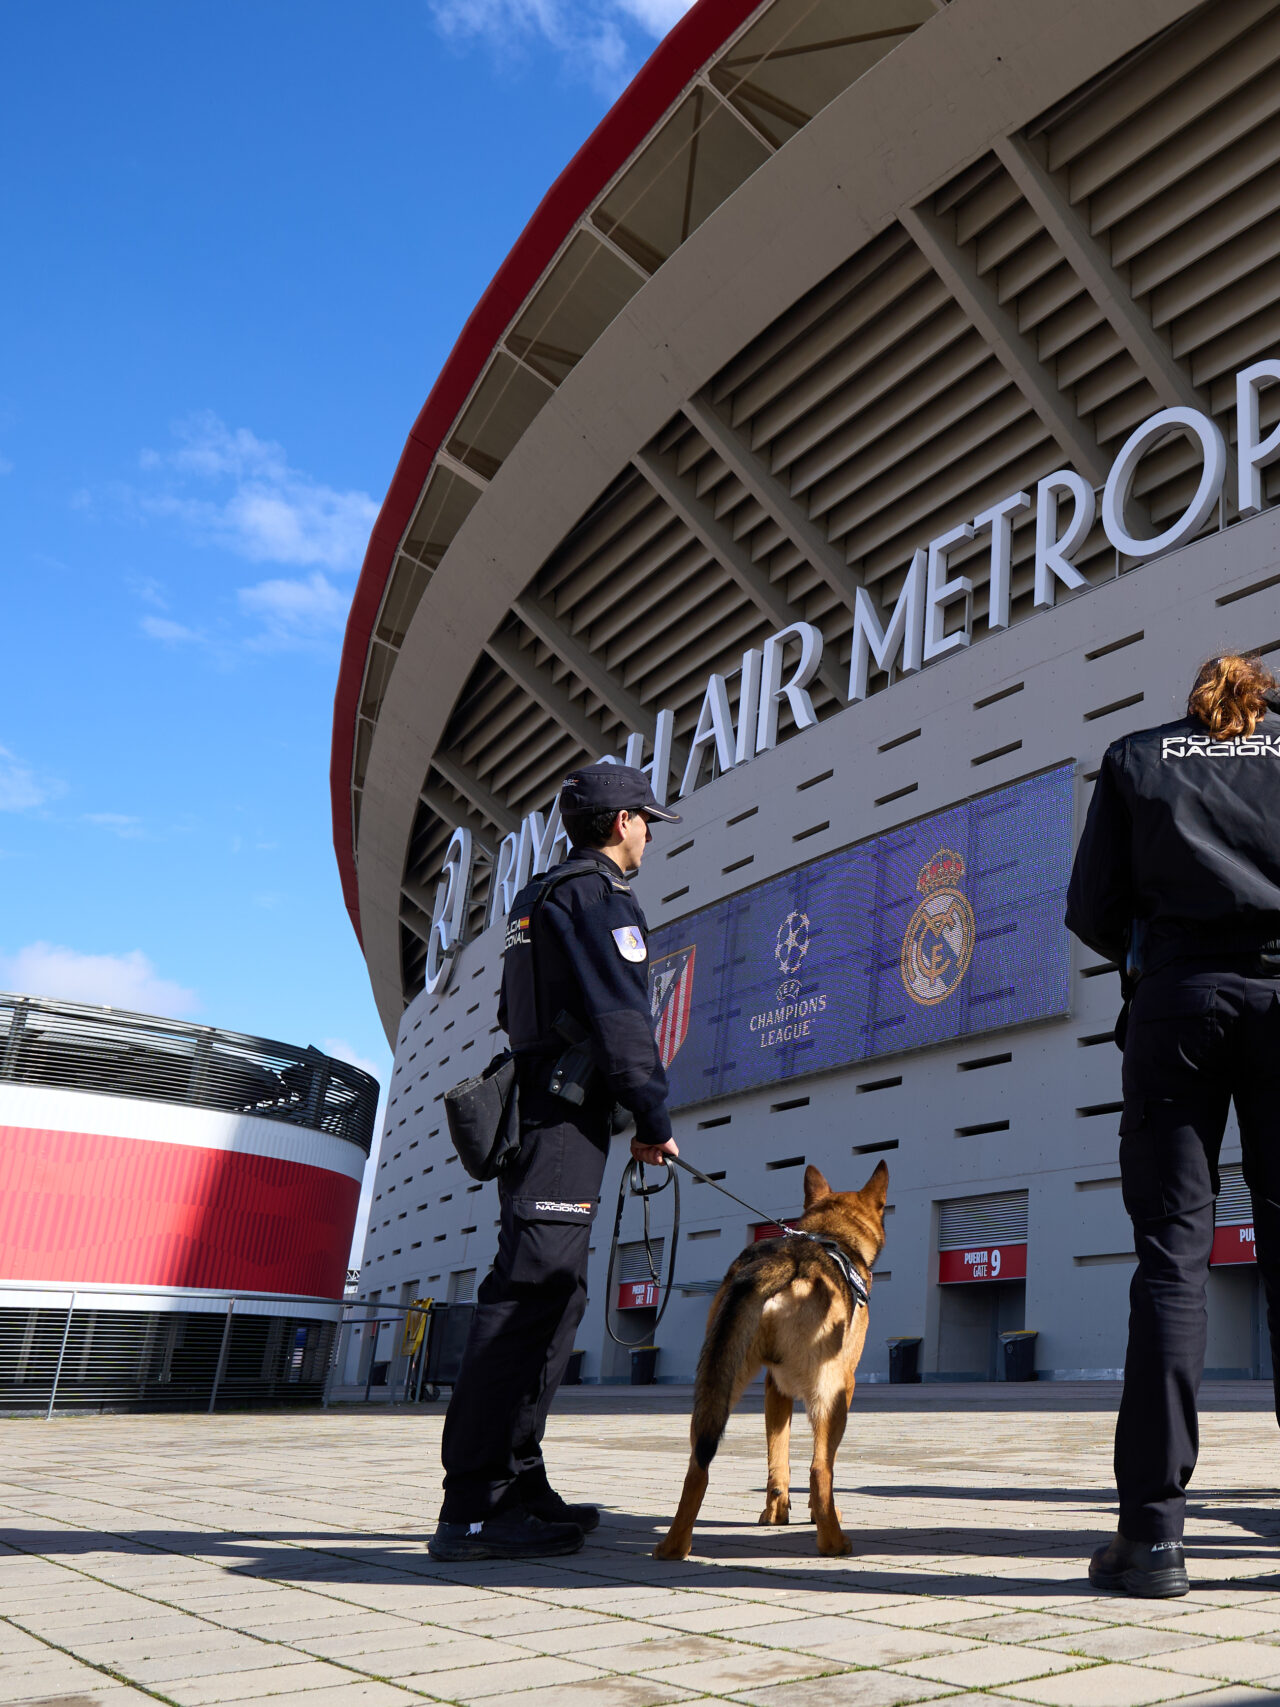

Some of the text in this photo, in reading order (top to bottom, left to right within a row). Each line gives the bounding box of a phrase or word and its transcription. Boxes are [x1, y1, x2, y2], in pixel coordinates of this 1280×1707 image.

[490, 708, 675, 928] RIYAH
[679, 622, 825, 797] AIR
[750, 994, 827, 1032] CHAMPIONS
[761, 1020, 811, 1048] LEAGUE
[535, 1204, 591, 1214] NACIONAL
[964, 1251, 988, 1265] PUERTA
[973, 1265, 988, 1278] GATE
[991, 1249, 1001, 1277] 9
